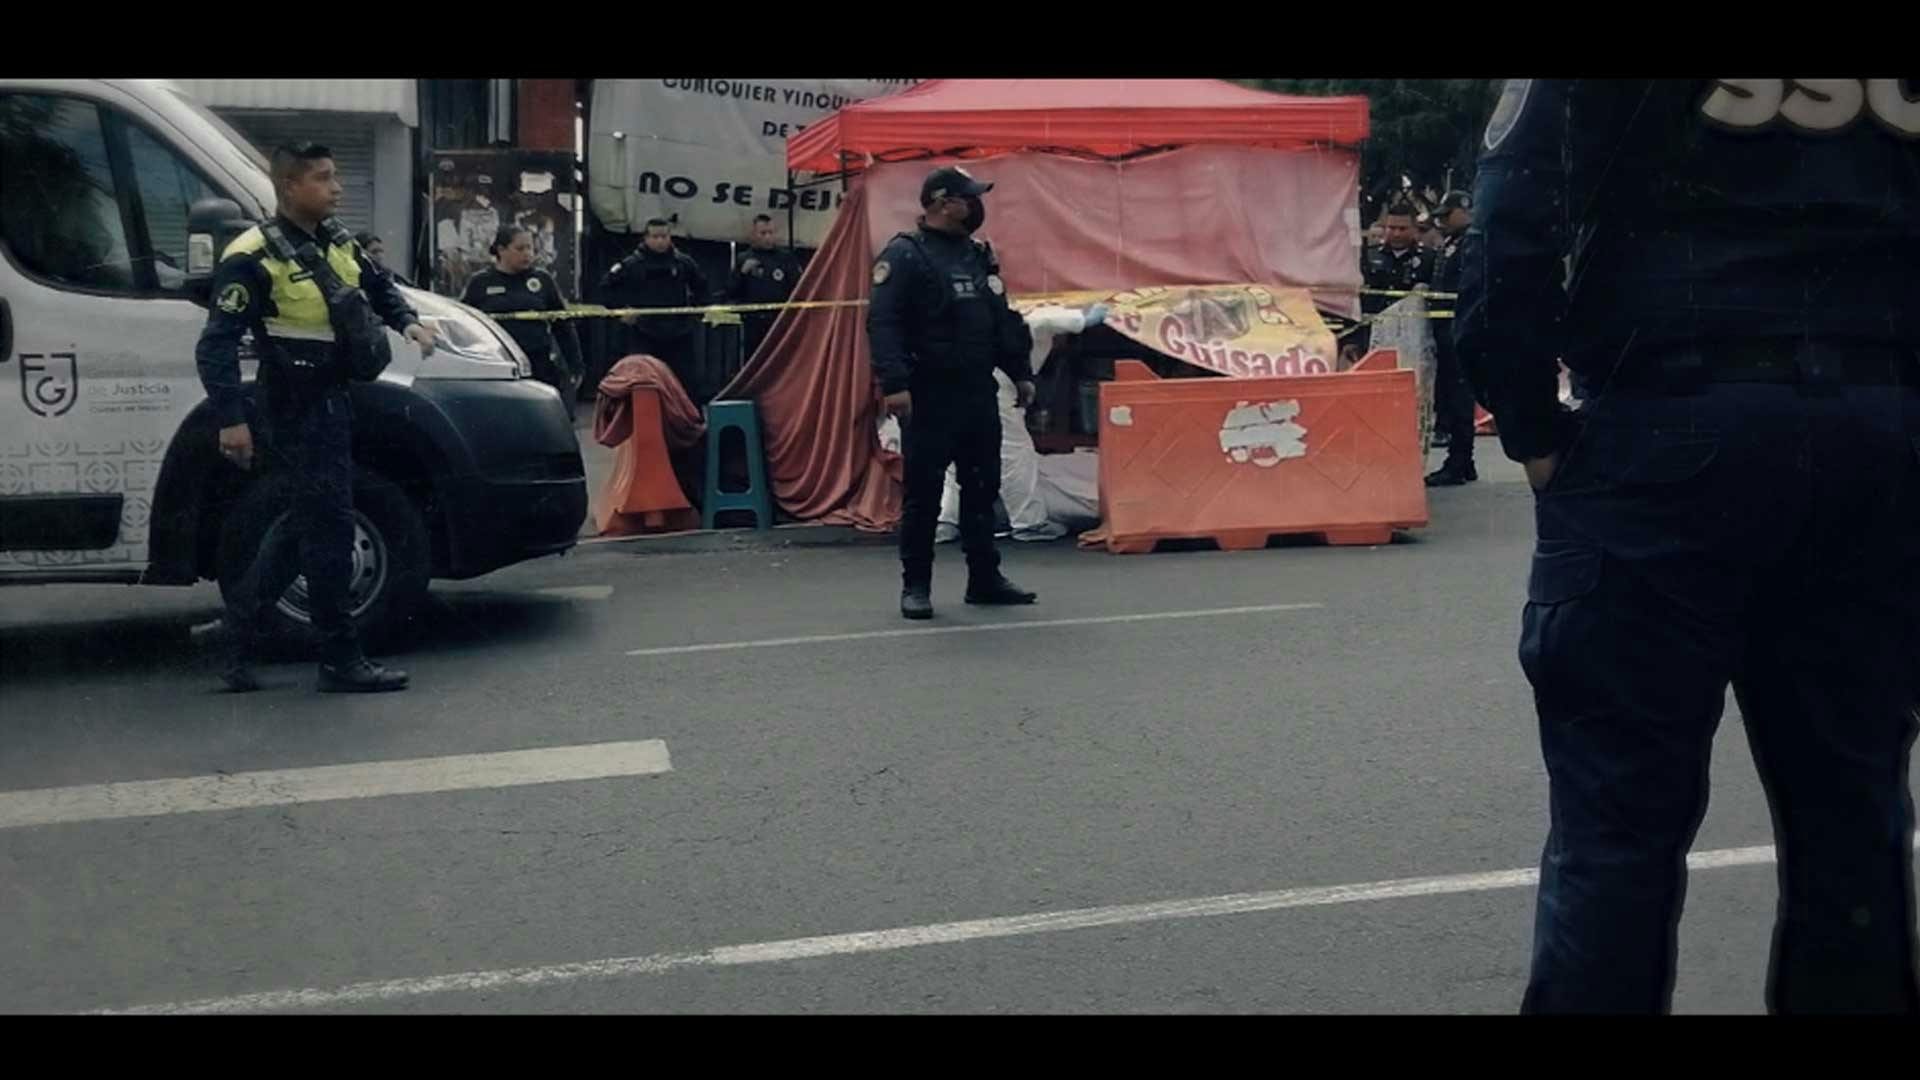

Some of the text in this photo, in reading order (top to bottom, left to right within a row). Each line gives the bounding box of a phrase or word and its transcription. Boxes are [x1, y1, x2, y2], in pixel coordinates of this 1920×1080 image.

[662, 79, 776, 102] CUALQUIER
[763, 121, 788, 137] DE
[639, 172, 698, 199] NO
[712, 182, 752, 206] SE
[1159, 314, 1328, 376] Guisado
[112, 383, 170, 396] Justicia
